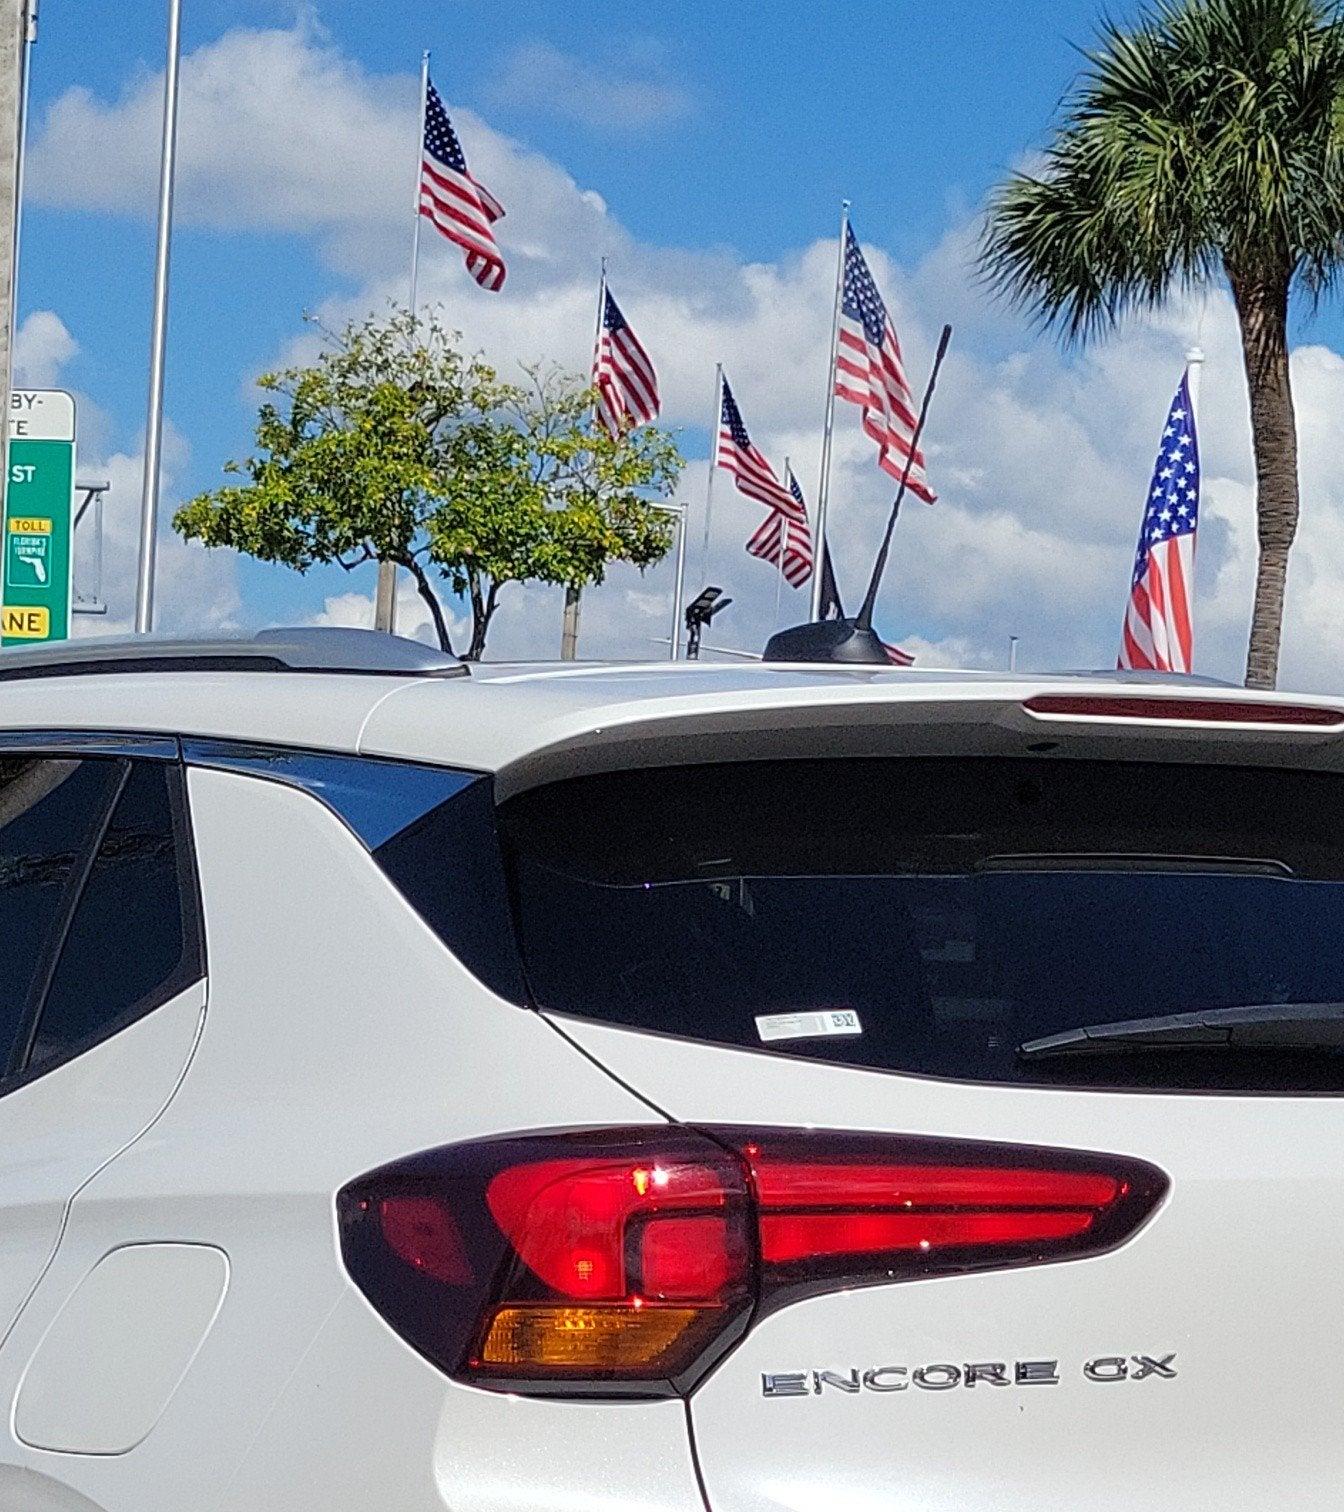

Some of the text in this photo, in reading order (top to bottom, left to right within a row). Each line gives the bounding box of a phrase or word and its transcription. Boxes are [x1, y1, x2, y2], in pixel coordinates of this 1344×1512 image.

[14, 520, 46, 531] TOLL
[761, 1353, 1178, 1397] ENCORE GX
